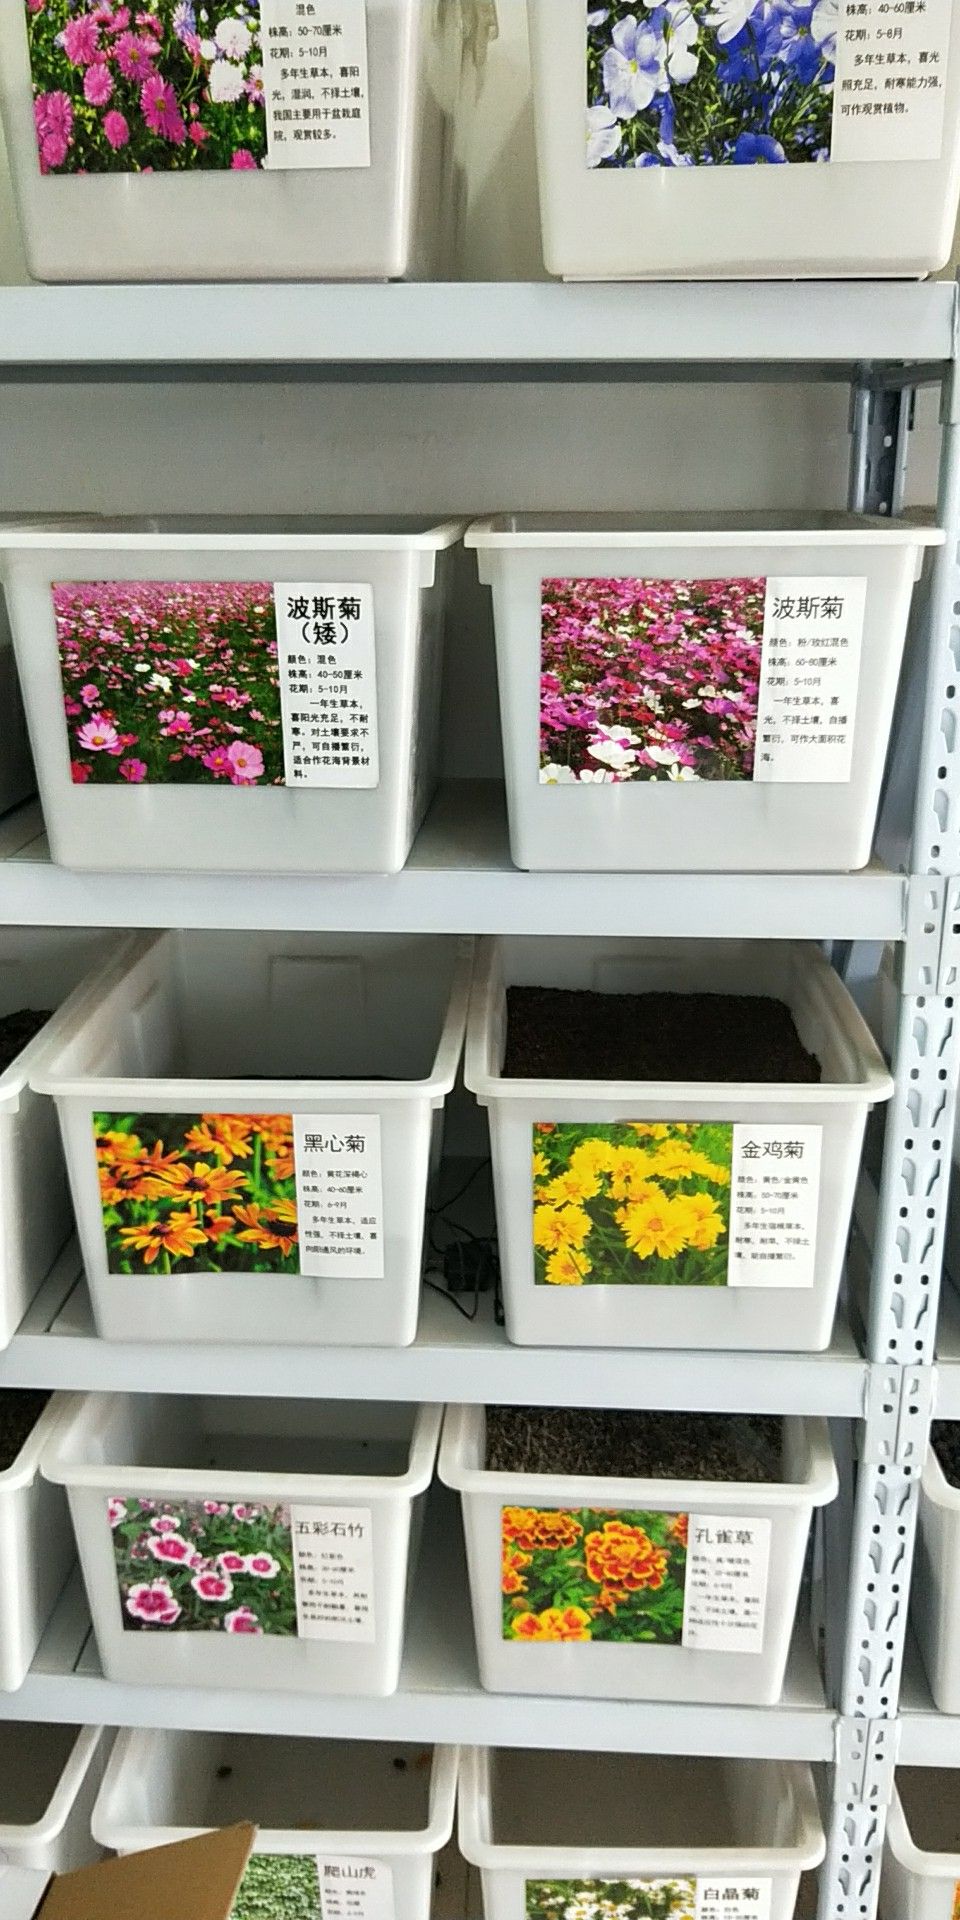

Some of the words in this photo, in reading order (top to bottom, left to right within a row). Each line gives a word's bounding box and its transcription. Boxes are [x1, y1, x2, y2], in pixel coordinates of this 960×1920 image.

[296, 4, 316, 16] 混色
[268, 24, 342, 38] 株高：50-70厘米
[270, 46, 327, 59] 花期：5-10月
[287, 595, 361, 620] 波斯菊
[772, 596, 844, 620] 波斯菊
[293, 755, 370, 766] 适合作花海背景材
[303, 1133, 366, 1153] 黑心菊
[741, 1140, 805, 1159] 金鸡菊
[295, 1521, 364, 1538] 五彩石竹
[695, 1528, 753, 1545] 孔雀草
[324, 1865, 376, 1880] 爬山虎
[704, 1887, 760, 1900] 白晶菊
